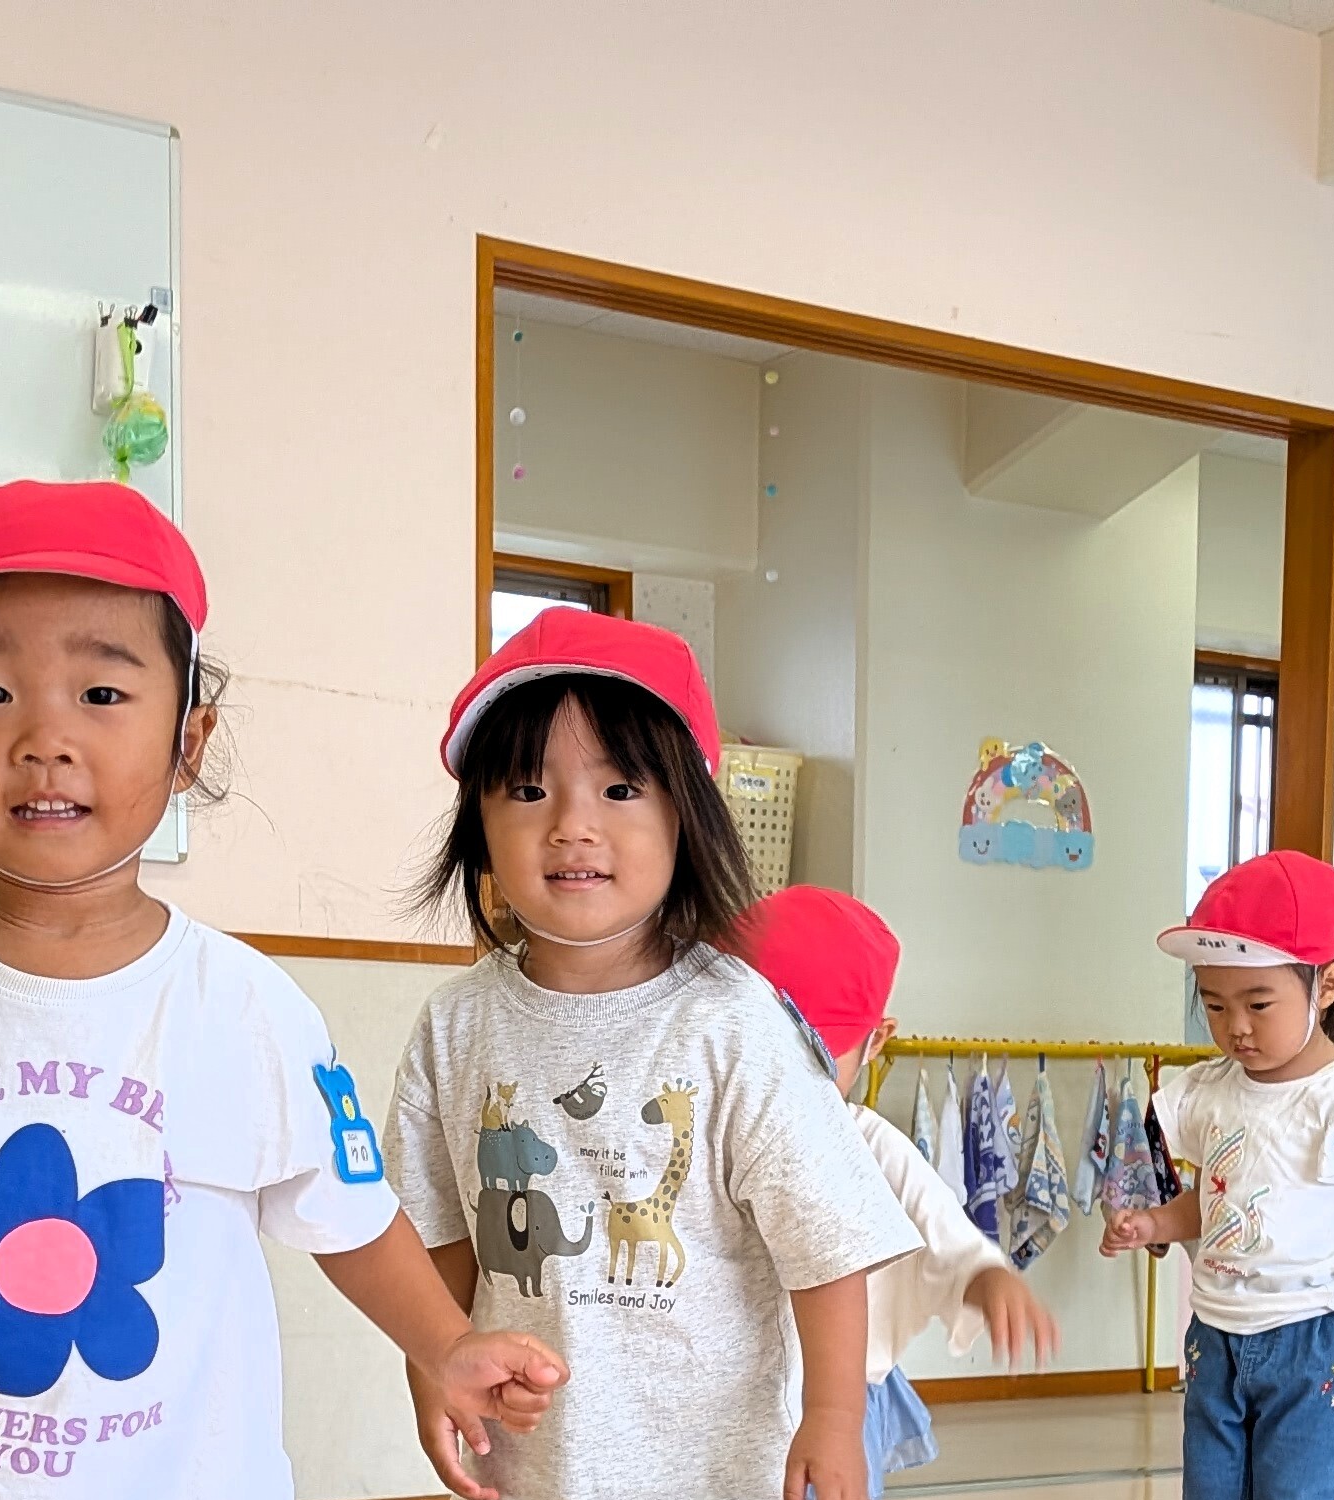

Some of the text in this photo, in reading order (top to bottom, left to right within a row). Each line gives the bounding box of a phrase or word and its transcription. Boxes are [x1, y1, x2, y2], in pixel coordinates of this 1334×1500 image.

[17, 1060, 104, 1099] MY
[580, 1147, 627, 1161] may it be
[599, 1164, 648, 1180] filled with
[567, 1287, 677, 1314] Smiles and Joy
[95, 1401, 163, 1443] FOR
